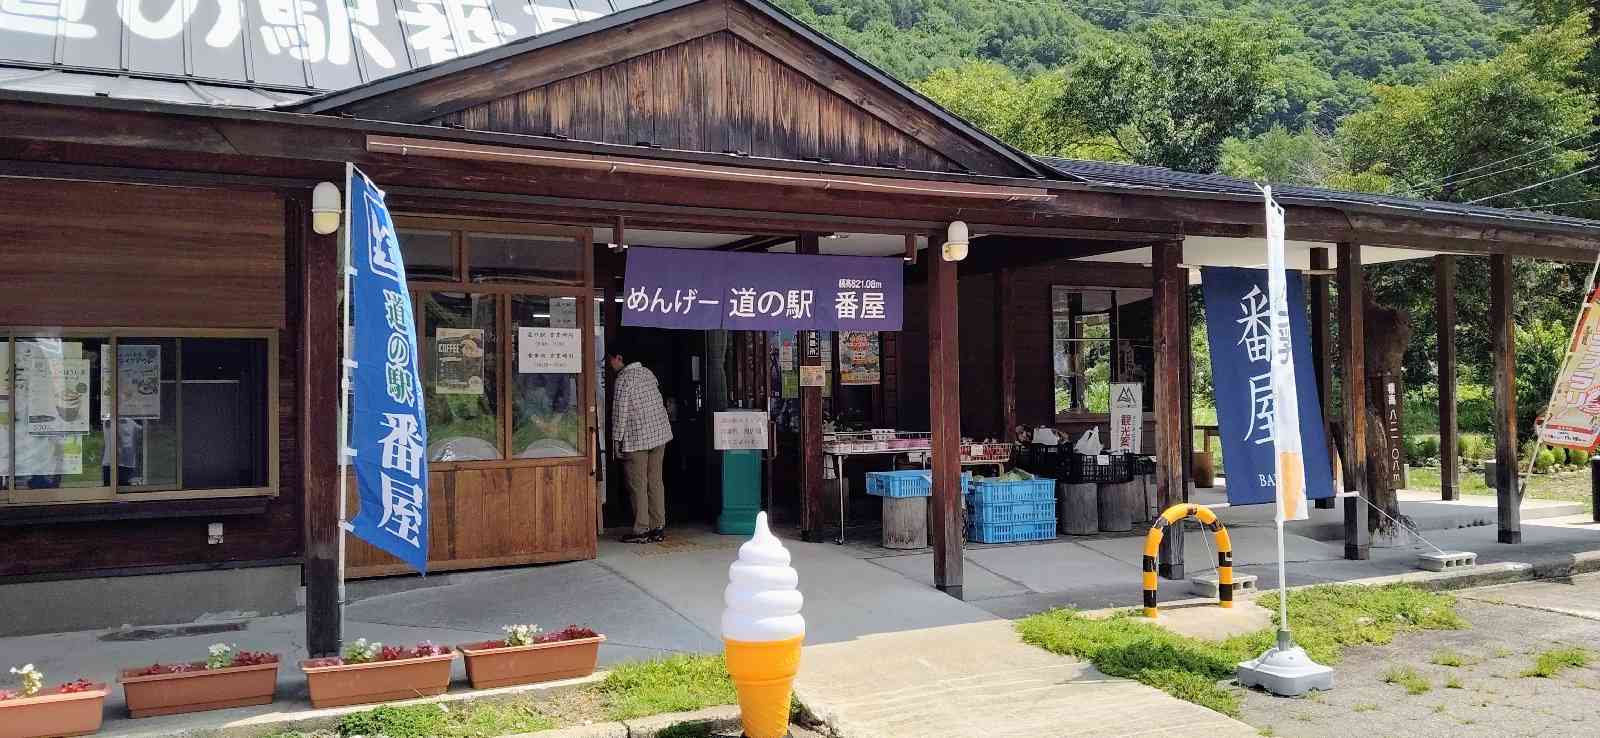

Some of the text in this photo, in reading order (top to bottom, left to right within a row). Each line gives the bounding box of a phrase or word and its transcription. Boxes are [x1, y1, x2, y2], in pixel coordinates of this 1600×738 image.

[626, 286, 886, 320] めんげー 道の駅 番屋
[1236, 283, 1275, 445] 番屋
[376, 289, 424, 548] 道の駅 番屋
